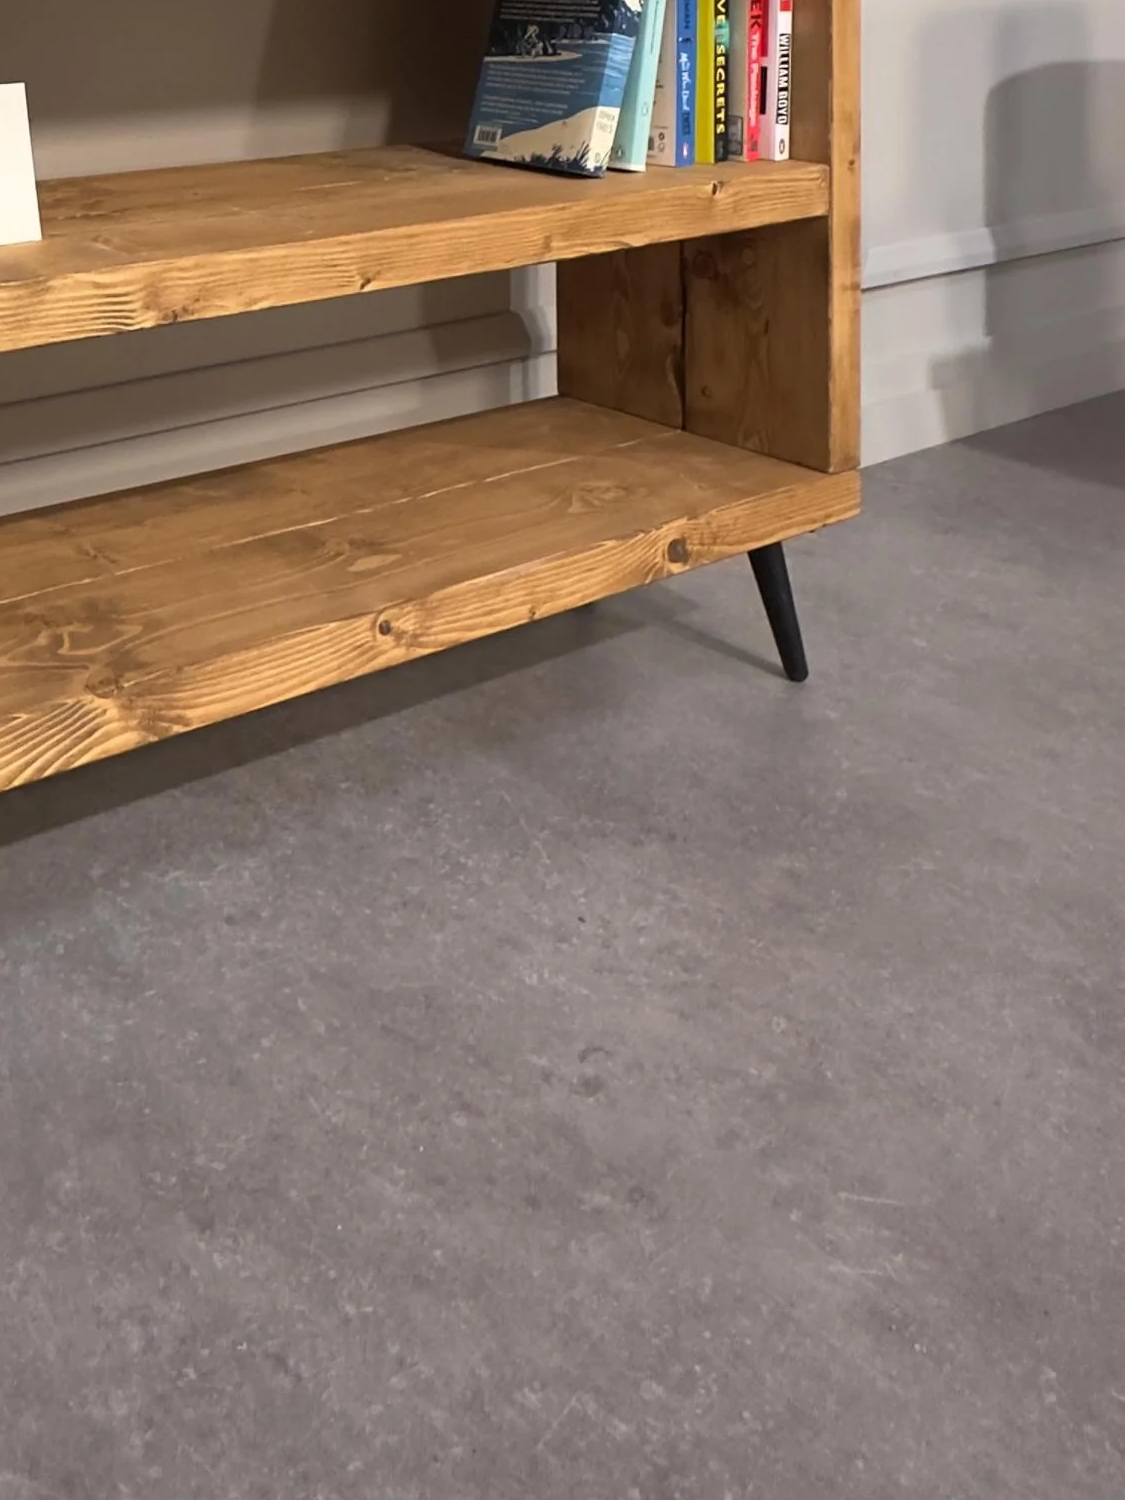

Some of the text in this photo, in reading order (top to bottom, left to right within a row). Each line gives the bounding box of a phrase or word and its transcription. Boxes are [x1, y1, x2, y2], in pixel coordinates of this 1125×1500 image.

[716, 43, 726, 134] SECRETS
[777, 32, 791, 125] WILLIAM BOYD
